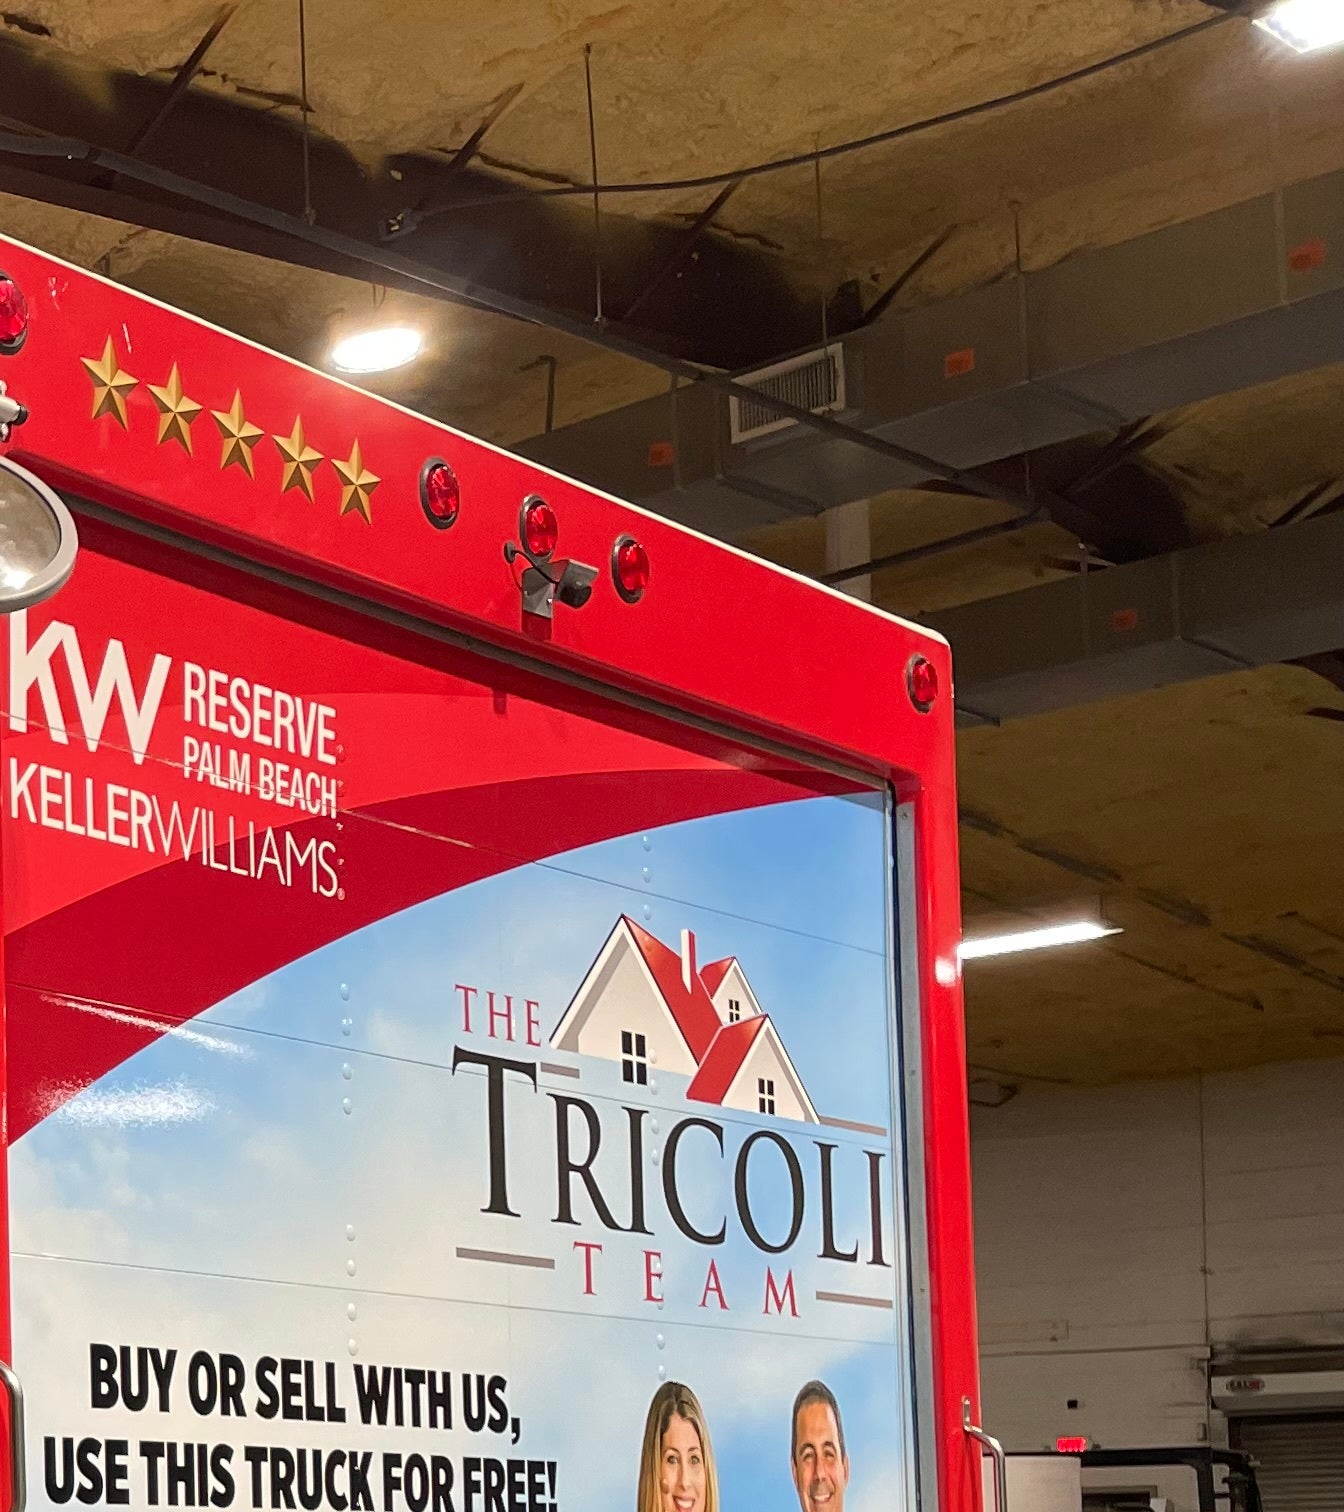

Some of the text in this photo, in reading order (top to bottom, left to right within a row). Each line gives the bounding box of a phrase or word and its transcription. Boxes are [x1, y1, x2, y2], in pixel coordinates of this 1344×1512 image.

[183, 661, 337, 765] RESERVE
[184, 736, 337, 820] PALM BEACH
[454, 984, 542, 1047] THE
[451, 1044, 892, 1267] TRICOLI
[573, 1240, 801, 1318] TEAM
[89, 1343, 521, 1445] BUY OR SELL WITH US,
[43, 1436, 130, 1506] USE
[139, 1440, 235, 1509] THIS
[244, 1444, 375, 1512] TRUCK
